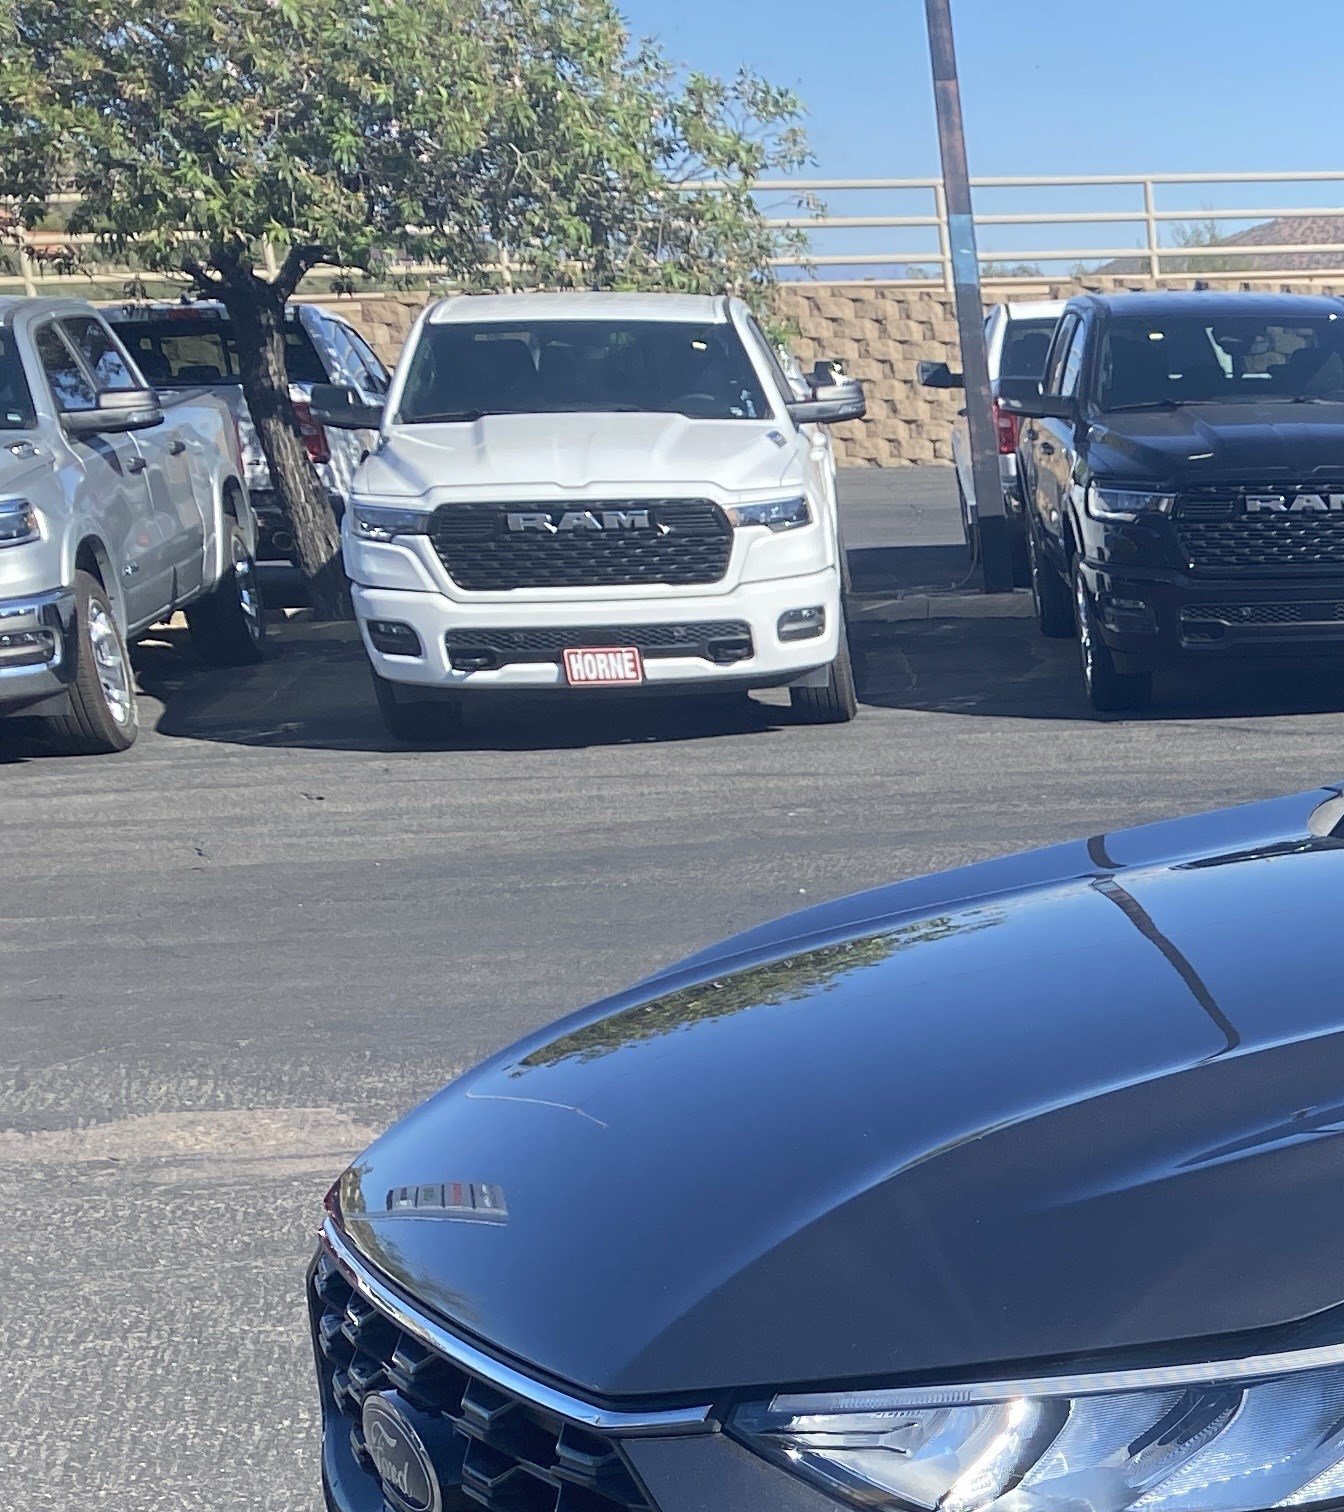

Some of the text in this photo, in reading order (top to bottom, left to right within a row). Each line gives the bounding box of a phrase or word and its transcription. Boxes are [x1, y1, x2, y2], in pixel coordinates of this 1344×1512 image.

[507, 509, 650, 533] RAM
[568, 651, 637, 681] HORNE
[368, 1420, 414, 1499] Ford
